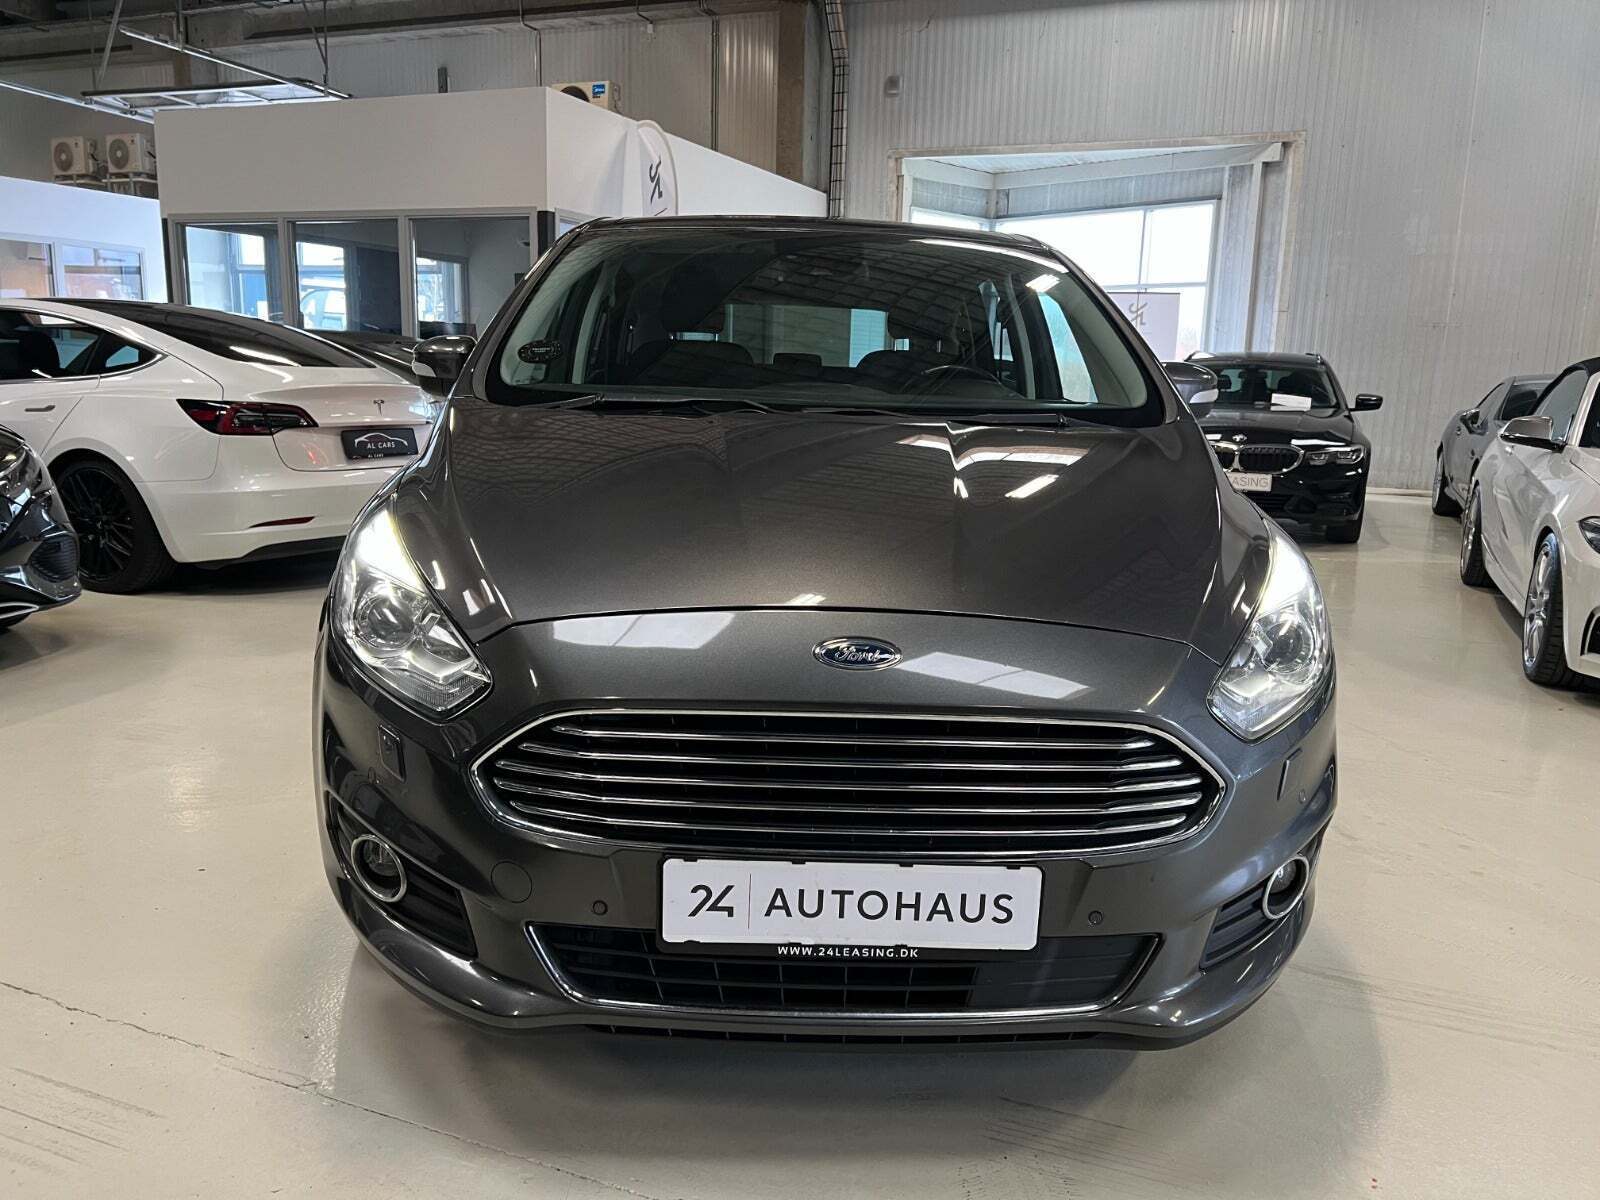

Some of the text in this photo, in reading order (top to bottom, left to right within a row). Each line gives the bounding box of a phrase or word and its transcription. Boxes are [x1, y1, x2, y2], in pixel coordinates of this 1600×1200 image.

[378, 441, 396, 449] CARS
[1231, 476, 1270, 488] ASING
[834, 645, 882, 662] Ford
[687, 884, 1014, 925] 24 AUTOHAUS
[777, 945, 919, 958] WWW.24LEASING.DK
